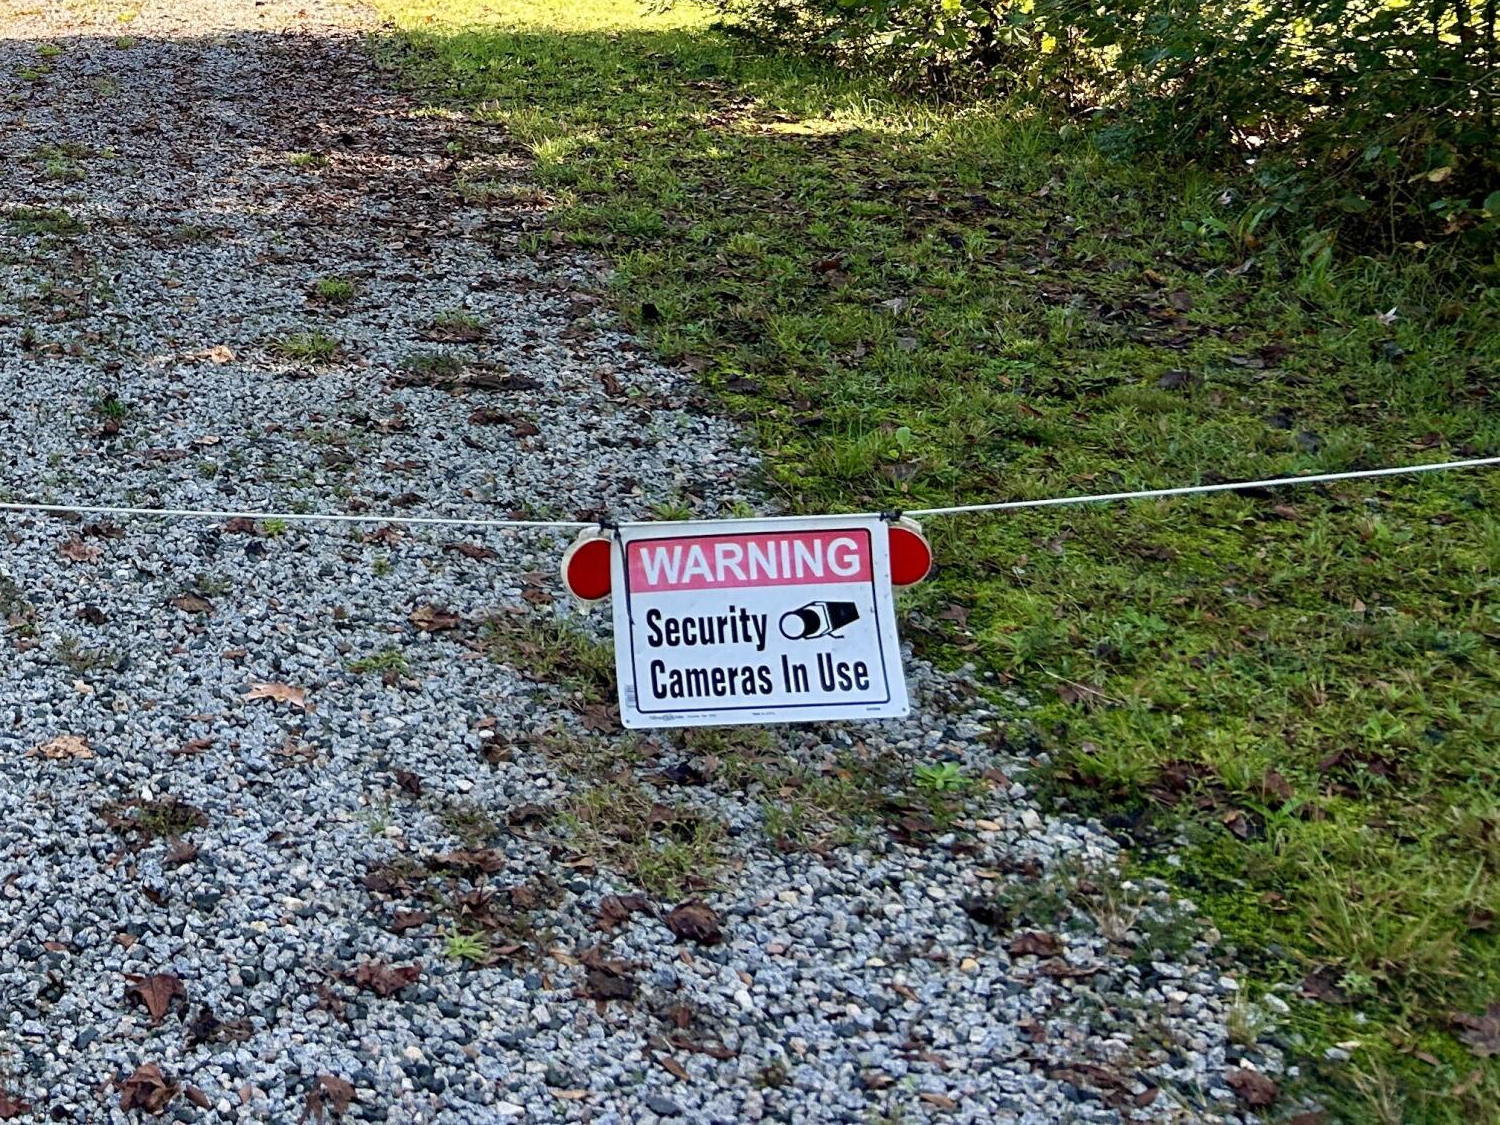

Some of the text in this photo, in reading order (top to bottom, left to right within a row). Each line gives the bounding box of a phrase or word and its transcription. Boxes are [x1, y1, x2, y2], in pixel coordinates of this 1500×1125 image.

[640, 537, 861, 586] WARNING
[646, 605, 768, 652] Security
[649, 652, 870, 700] Cameras In Use
